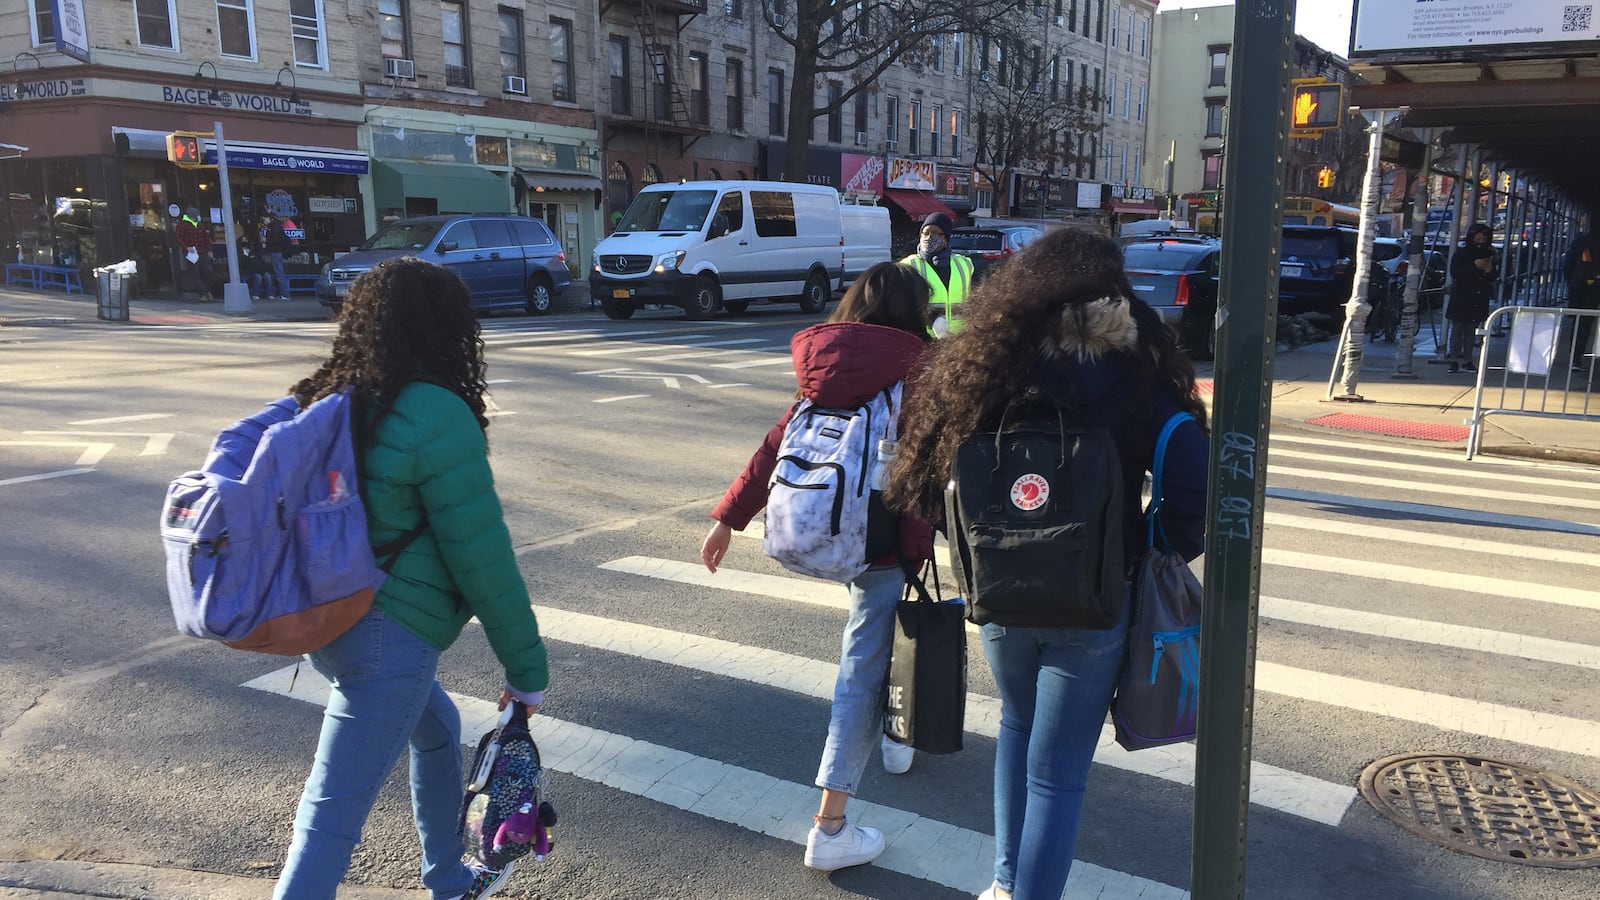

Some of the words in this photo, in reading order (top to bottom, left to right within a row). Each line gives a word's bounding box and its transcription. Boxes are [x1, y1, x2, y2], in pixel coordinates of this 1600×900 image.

[24, 80, 69, 99] WORLD
[162, 86, 216, 107] BAGEL
[235, 93, 291, 113] WORLD
[262, 157, 288, 168] BAGEL
[295, 159, 325, 169] WORLD
[914, 161, 935, 188] PIZZA
